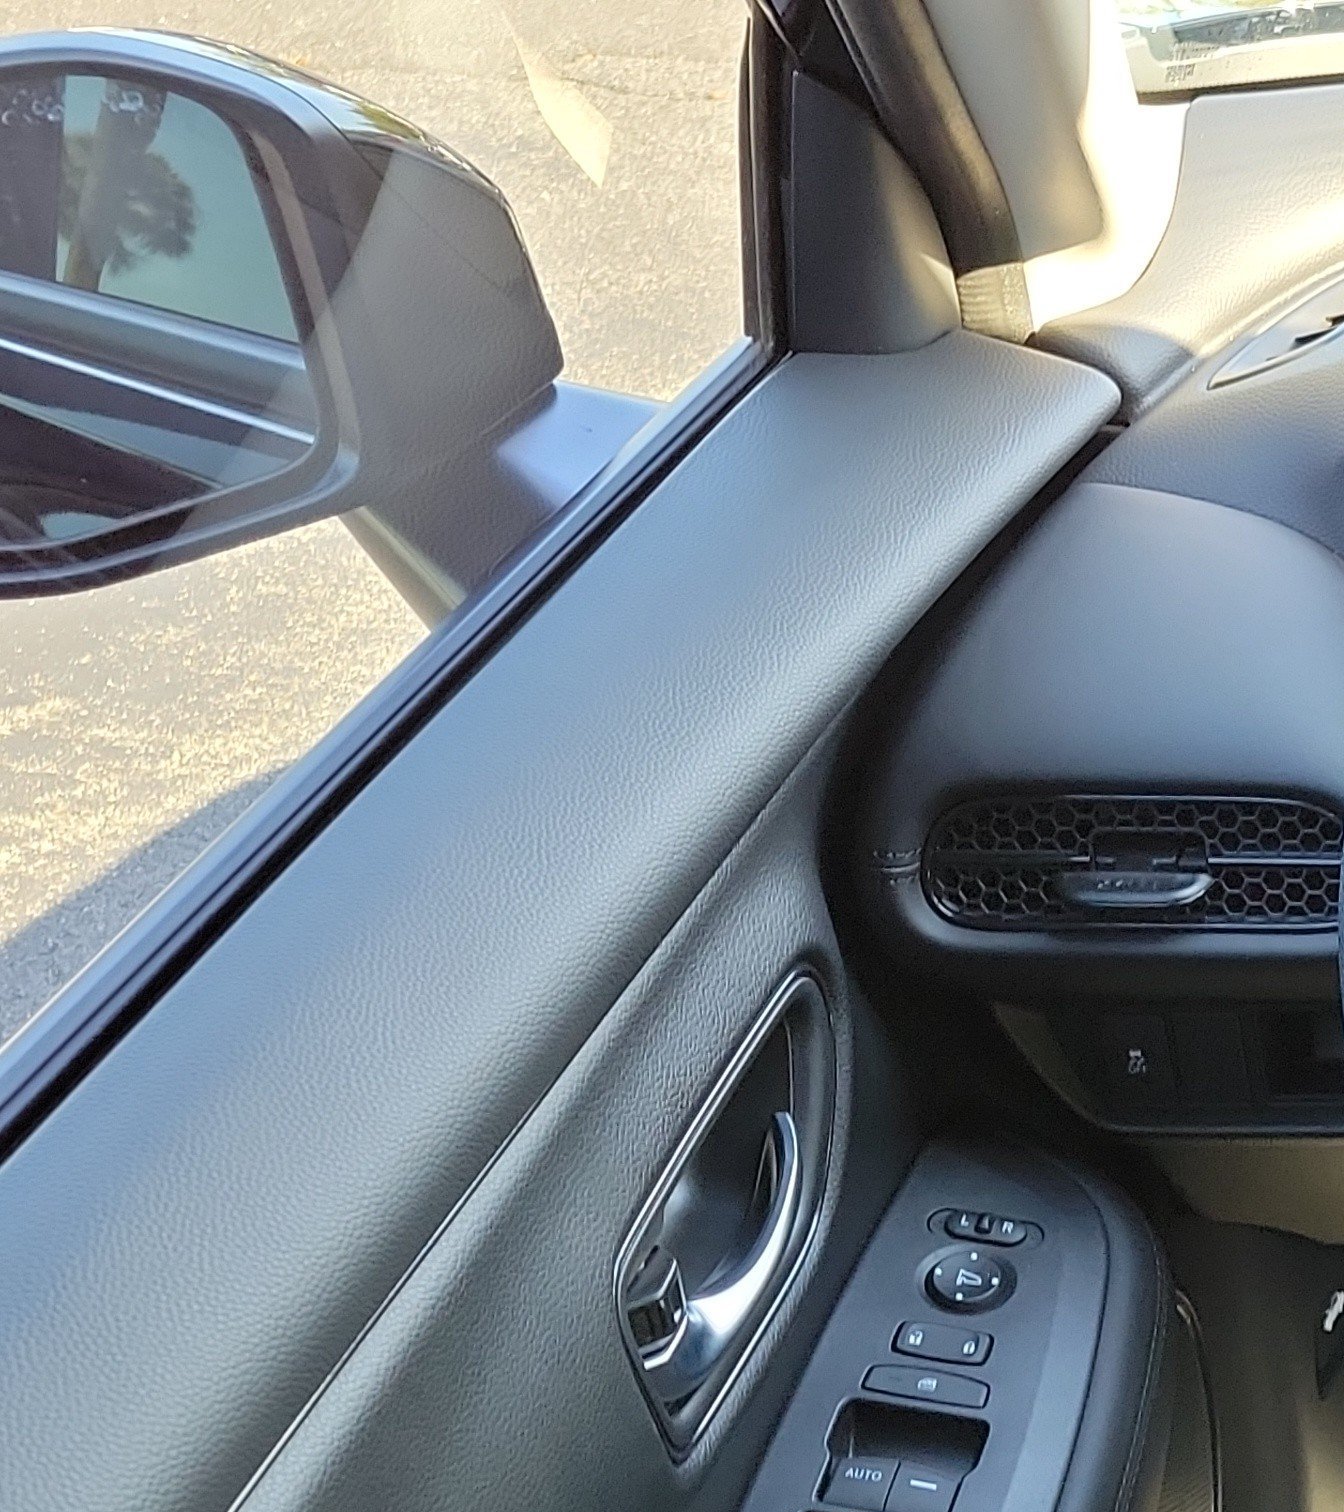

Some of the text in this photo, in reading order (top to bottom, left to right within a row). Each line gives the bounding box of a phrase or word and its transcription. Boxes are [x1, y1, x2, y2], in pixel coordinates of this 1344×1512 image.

[959, 1215, 970, 1228] L
[1001, 1220, 1014, 1235] R
[845, 1467, 883, 1483] AUTO
